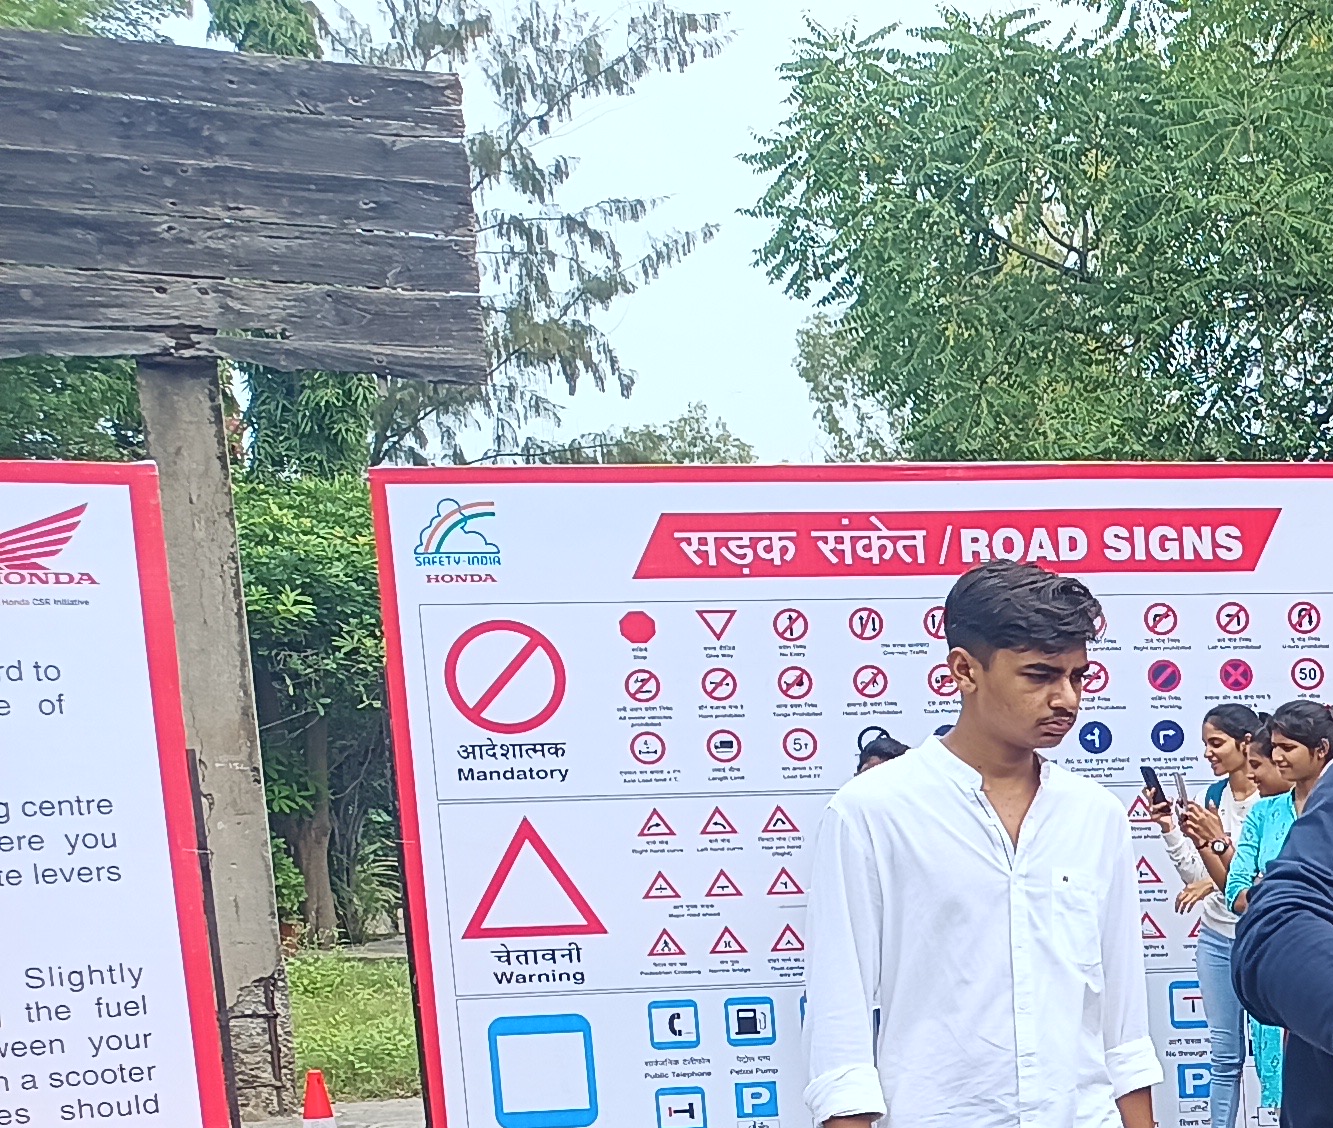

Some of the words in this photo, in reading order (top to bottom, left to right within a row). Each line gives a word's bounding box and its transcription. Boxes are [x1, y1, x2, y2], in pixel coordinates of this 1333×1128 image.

[674, 530, 797, 575] सड़क
[811, 515, 927, 565] संकेत
[1103, 525, 1243, 562] SIGNS
[0, 571, 100, 585] ONDA
[426, 574, 498, 583] HONDA
[33, 661, 61, 681] to
[1299, 667, 1317, 681] 50
[38, 693, 65, 716] of
[457, 737, 566, 760] आदेशात्मक
[457, 767, 569, 783] Mandatory
[22, 796, 113, 817] centre
[64, 832, 117, 856] you
[33, 863, 121, 884] levers
[490, 942, 582, 966] चेतावनी
[25, 963, 143, 992] Slightly
[493, 969, 585, 985] Warning
[25, 1001, 71, 1023] the
[95, 995, 147, 1018] fuel
[88, 1032, 152, 1058] your
[21, 1074, 39, 1091] a
[49, 1064, 156, 1088] scooter
[60, 1093, 159, 1121] should
[742, 1086, 771, 1114] P
